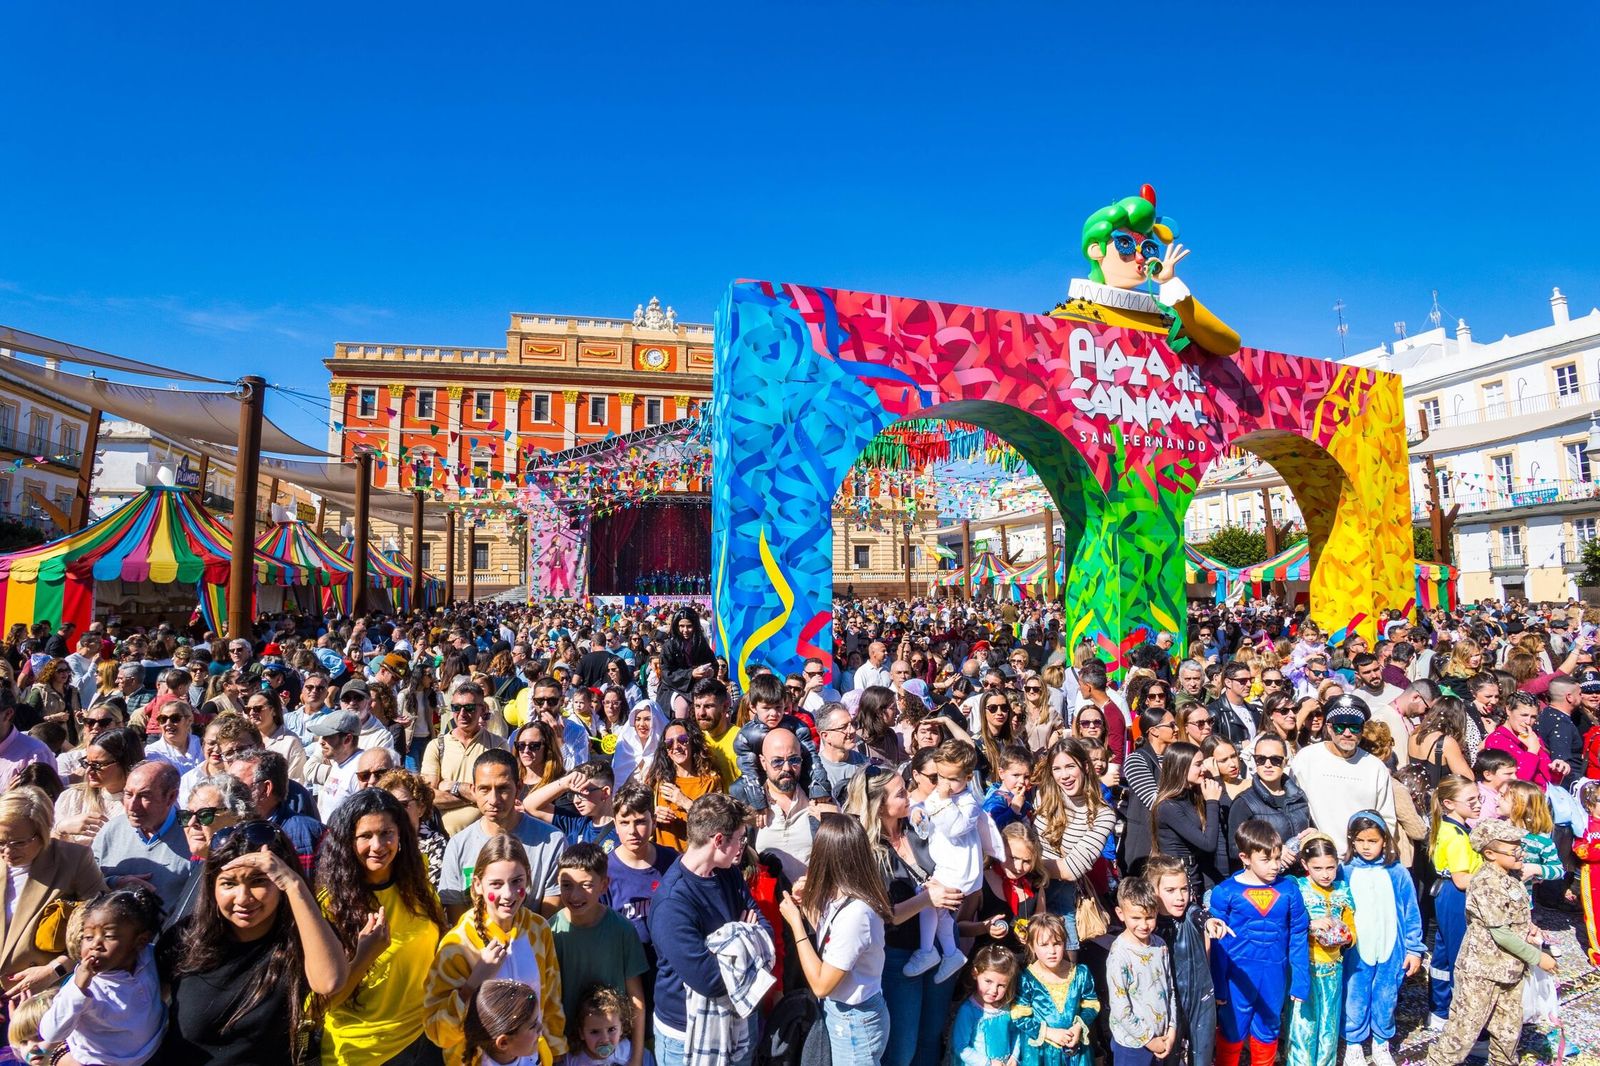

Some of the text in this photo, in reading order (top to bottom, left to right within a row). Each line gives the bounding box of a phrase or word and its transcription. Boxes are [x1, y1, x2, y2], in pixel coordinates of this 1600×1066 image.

[1069, 328, 1171, 386] PLAZA
[1069, 377, 1208, 433] CARNAVAL
[1080, 430, 1206, 452] SAN FERNANDO
